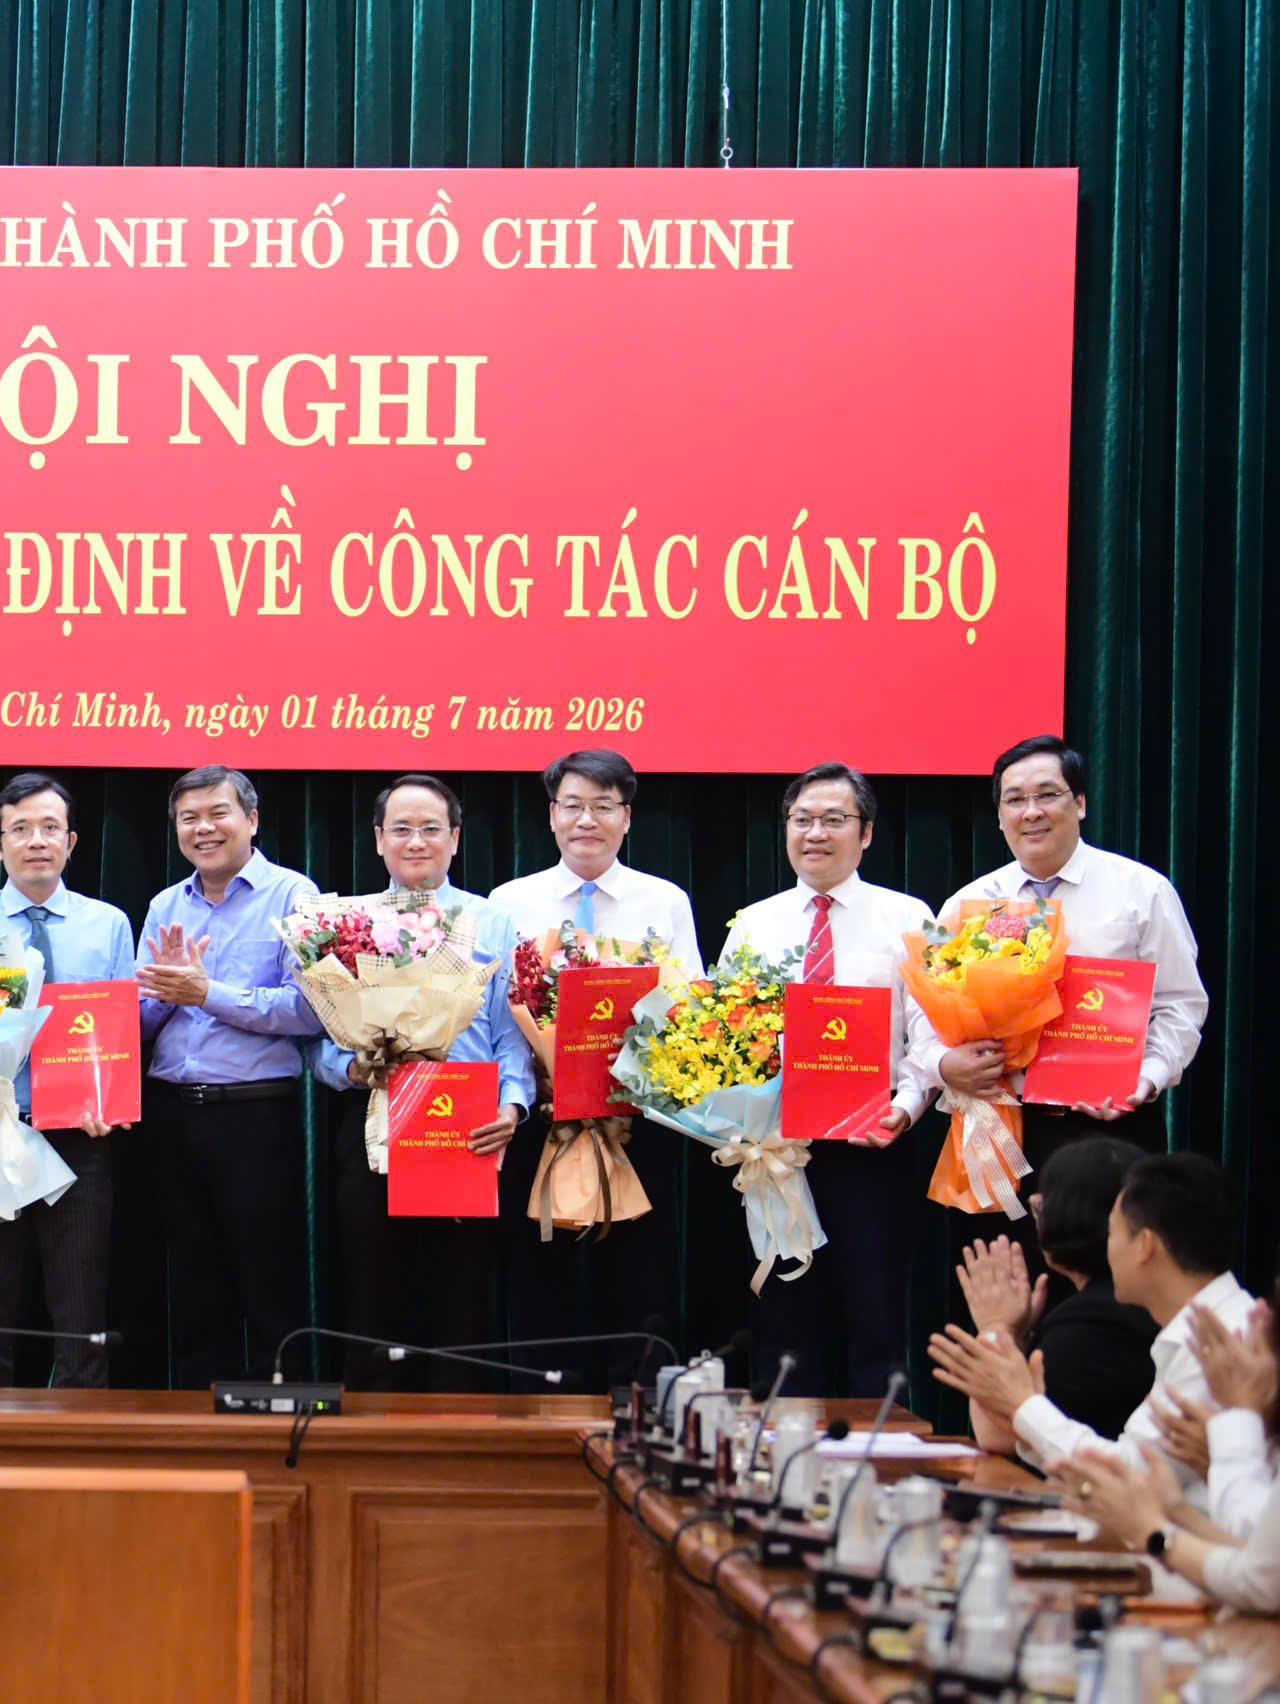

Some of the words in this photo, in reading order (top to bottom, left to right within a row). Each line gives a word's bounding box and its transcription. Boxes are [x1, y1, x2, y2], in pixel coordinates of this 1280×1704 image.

[208, 192, 347, 270] PHỐ
[367, 188, 461, 270] HỒ
[482, 201, 598, 270] CHÍ
[617, 217, 795, 271] MINH
[169, 353, 488, 470] NGHỊ
[3, 532, 188, 636] ĐỊNH
[209, 484, 301, 616] VỀ
[330, 508, 533, 618] CÔNG
[556, 507, 697, 619] TÁC
[724, 508, 876, 620] CÁN
[897, 512, 996, 644] BỘ
[1, 692, 61, 727] Chí
[72, 692, 170, 735] Minh,
[184, 694, 269, 737] ngày
[281, 695, 318, 729] 01
[331, 694, 435, 738] tháng
[448, 696, 467, 730] 7
[477, 697, 553, 730] năm
[565, 697, 645, 731] 2026
